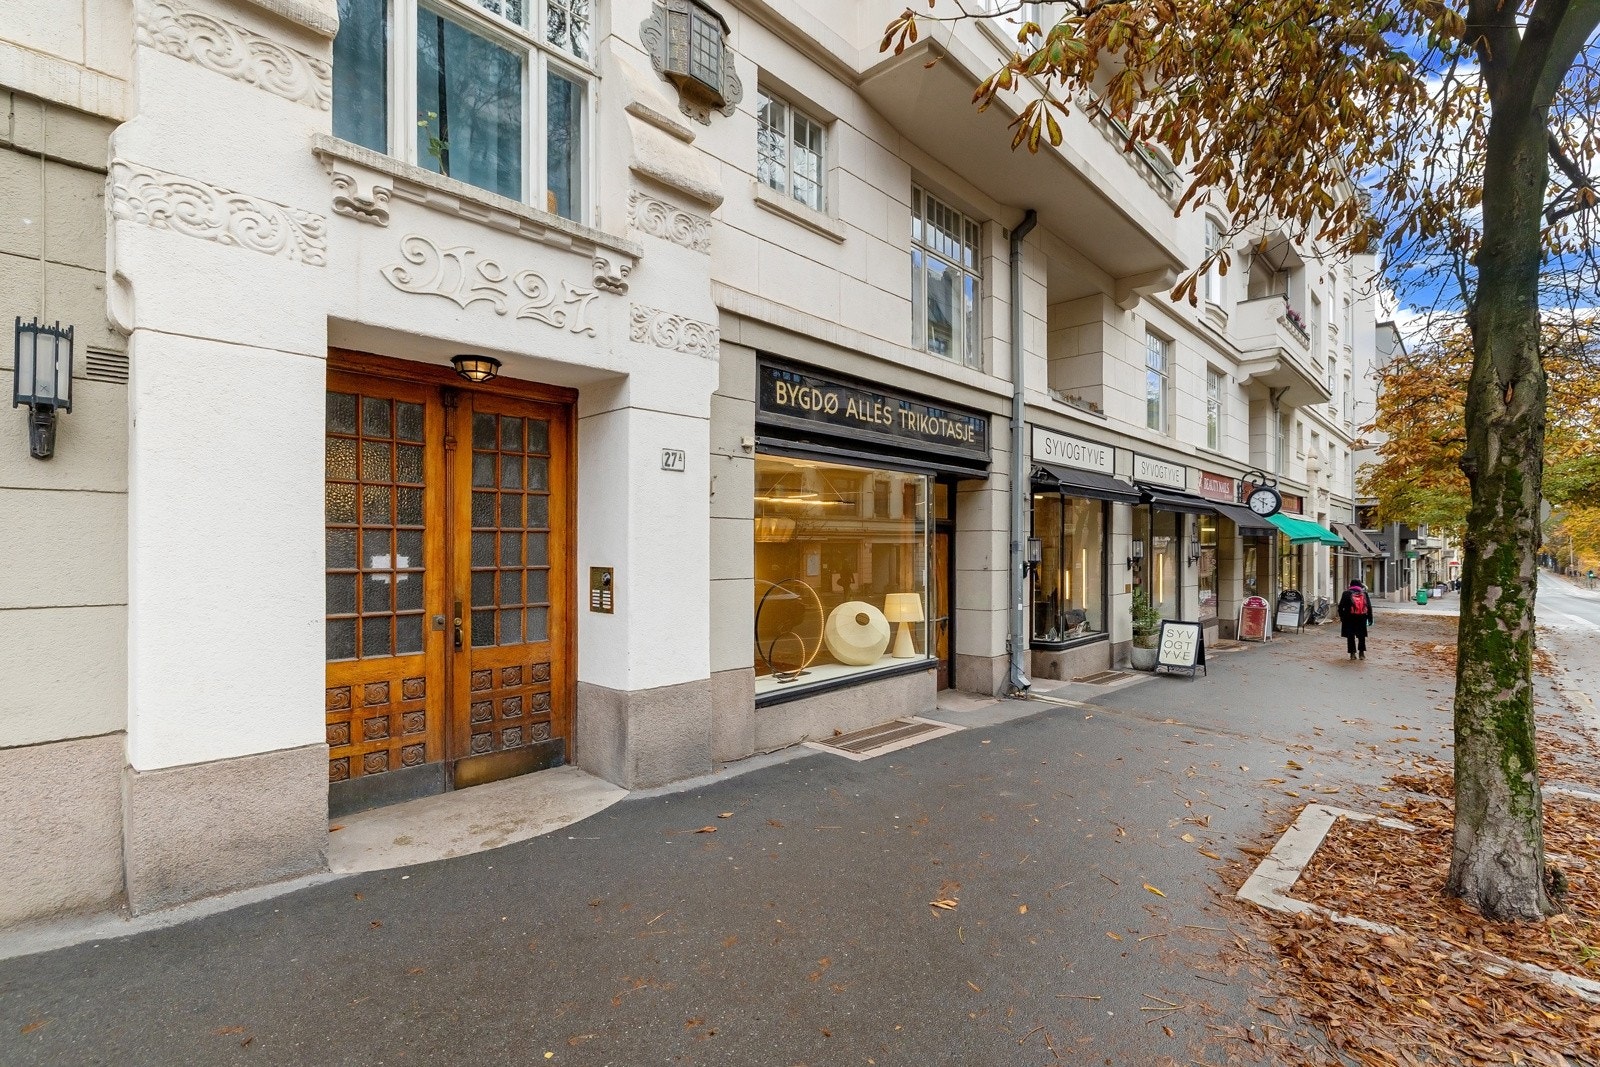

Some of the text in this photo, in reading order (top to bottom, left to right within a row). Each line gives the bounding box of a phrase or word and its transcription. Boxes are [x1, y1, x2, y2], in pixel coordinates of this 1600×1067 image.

[513, 269, 599, 338] 27
[776, 381, 975, 443] BYGDØ ALLÉS TRIKOTASJE
[1045, 437, 1105, 466] SYVOGTYVE
[1141, 461, 1180, 483] SYVOGTYVE
[1166, 628, 1194, 639] SYV
[1163, 650, 1190, 661] YVE
[1164, 640, 1192, 650] OGT
